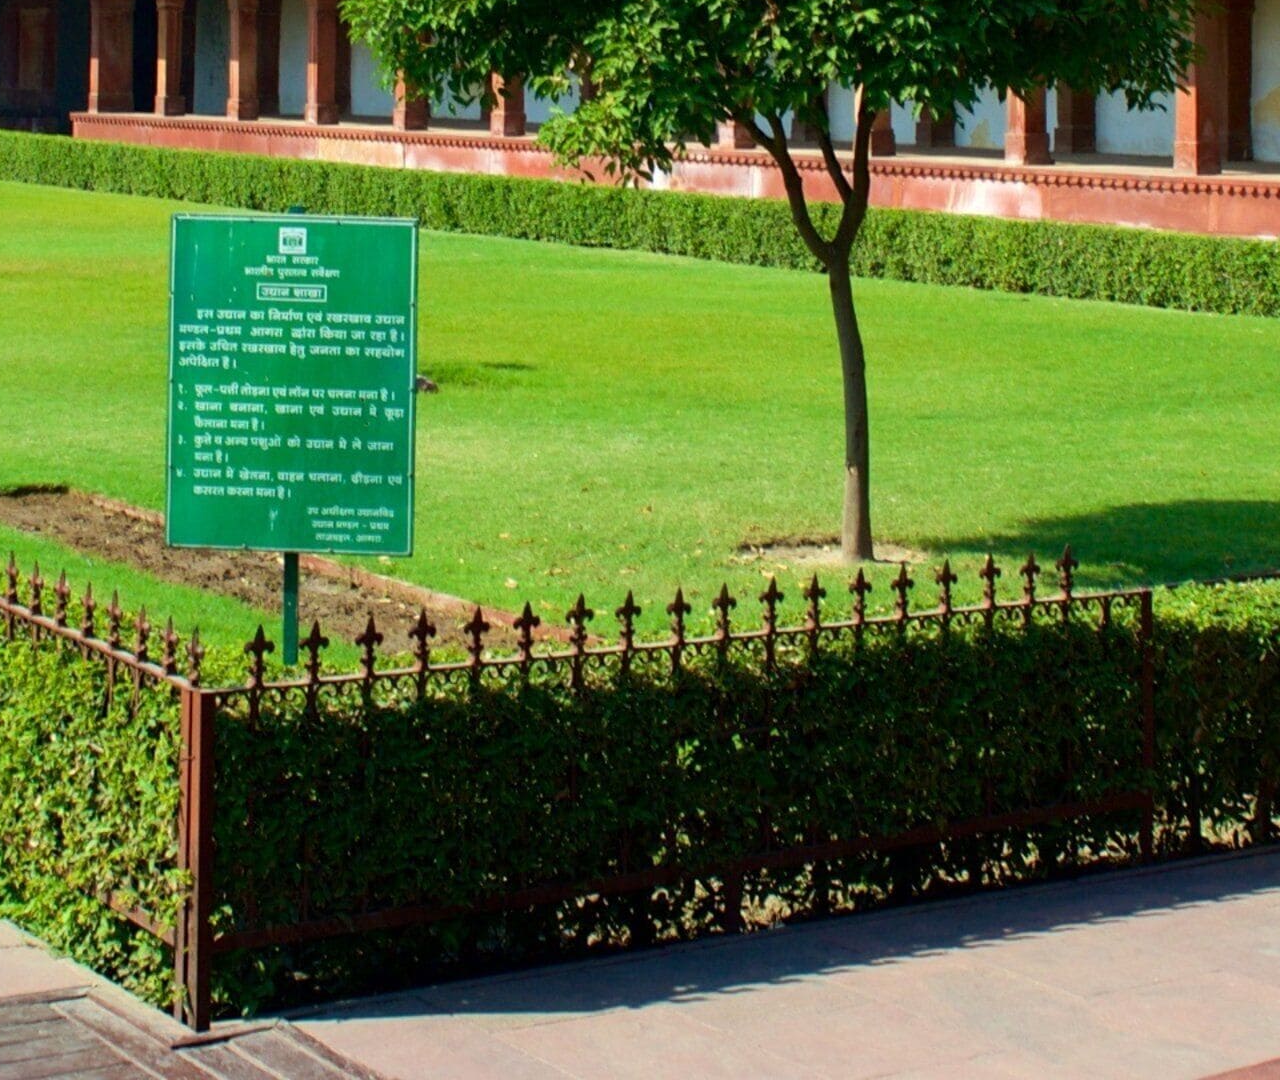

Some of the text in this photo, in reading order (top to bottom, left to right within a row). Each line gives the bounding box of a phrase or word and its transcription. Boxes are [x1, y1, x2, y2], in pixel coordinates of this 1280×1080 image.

[216, 309, 246, 320] उद्यान
[249, 310, 265, 320] का
[375, 314, 405, 325] उद्यान
[319, 325, 347, 340] किया
[351, 330, 366, 340] जा
[370, 331, 386, 342] रहा
[345, 346, 360, 356] का
[312, 389, 325, 399] पर
[332, 406, 362, 417] उद्यान
[287, 435, 301, 448] को
[306, 439, 334, 449] उद्यान
[367, 441, 394, 451] जाना
[193, 468, 222, 478] उद्यान
[227, 486, 254, 496] करना
